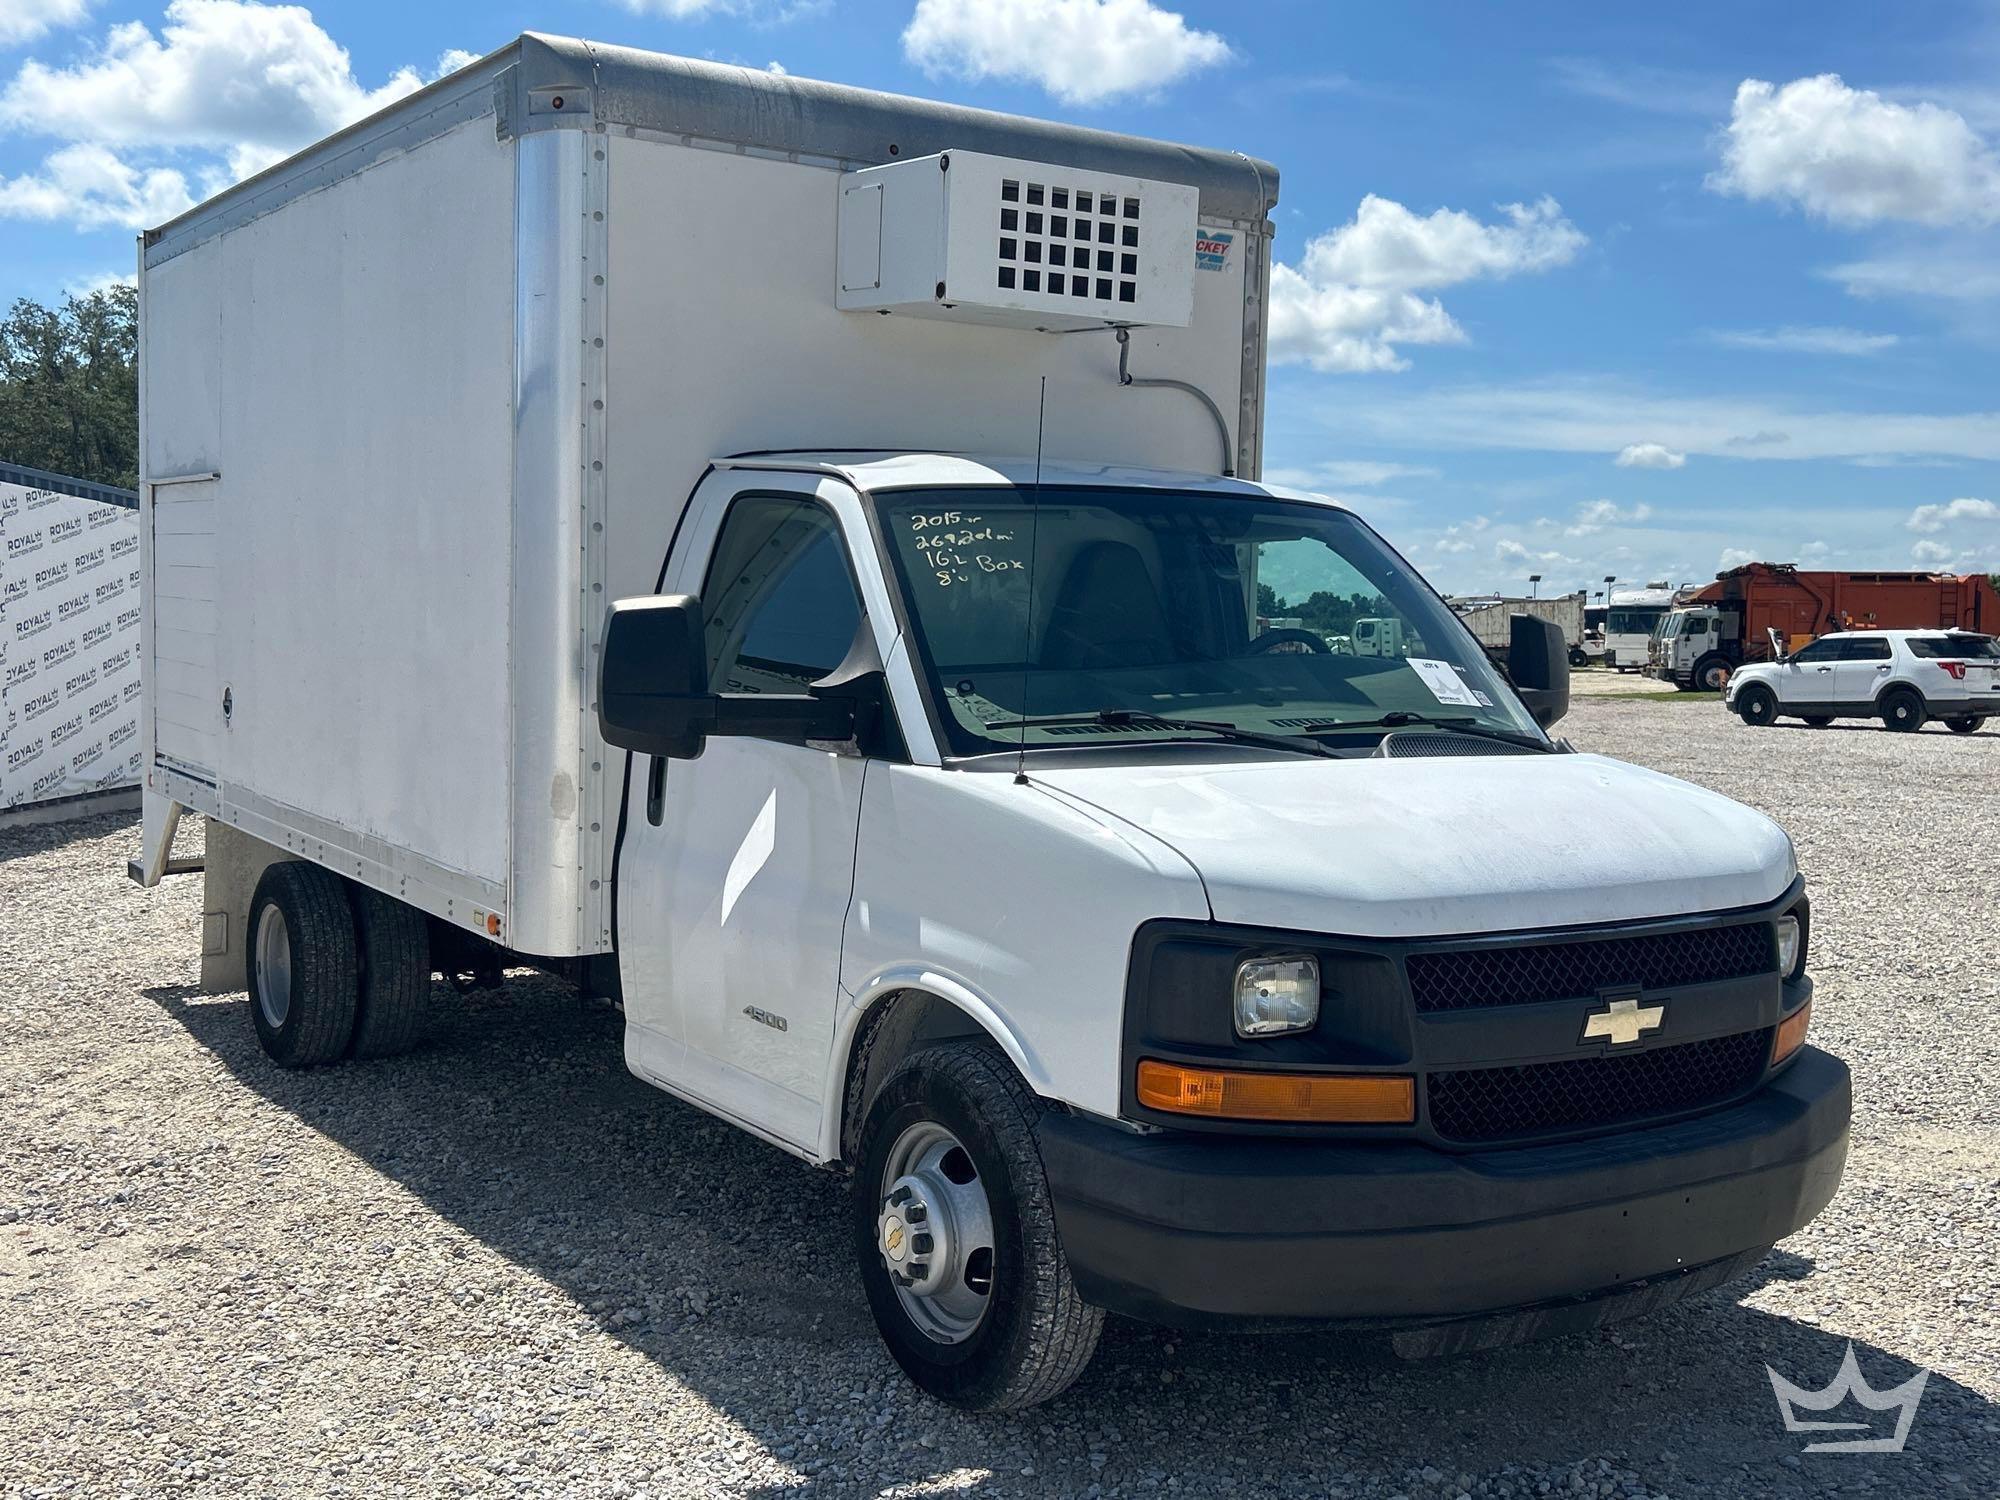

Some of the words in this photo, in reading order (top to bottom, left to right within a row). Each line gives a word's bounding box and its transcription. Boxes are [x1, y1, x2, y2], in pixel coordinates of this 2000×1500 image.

[1196, 240, 1229, 255] CKEY
[88, 507, 112, 523] ROYAL
[912, 512, 962, 531] 2015
[50, 520, 75, 536] ROYAL
[8, 533, 36, 551] ROYAL
[110, 537, 133, 553] ROYAL
[75, 550, 99, 568] ROYAL
[976, 555, 1024, 572] Box
[35, 564, 61, 584] ROYAL
[96, 580, 118, 598] ROYAL
[58, 597, 83, 615] ROYAL
[16, 614, 44, 633] ROYAL
[117, 608, 139, 625] ROYAL
[82, 624, 106, 643] ROYAL
[43, 643, 69, 663] ROYAL
[102, 653, 125, 671] ROYAL
[65, 672, 91, 692] ROYAL
[24, 693, 52, 714] ROYAL
[89, 698, 112, 717] ROYAL
[51, 719, 76, 740] ROYAL
[109, 723, 131, 744] ROYAL
[8, 744, 36, 764] ROYAL
[73, 745, 97, 767] ROYAL
[33, 769, 58, 791] ROYAL
[96, 769, 119, 790] ROYAL
[743, 1005, 787, 1032] 4500
